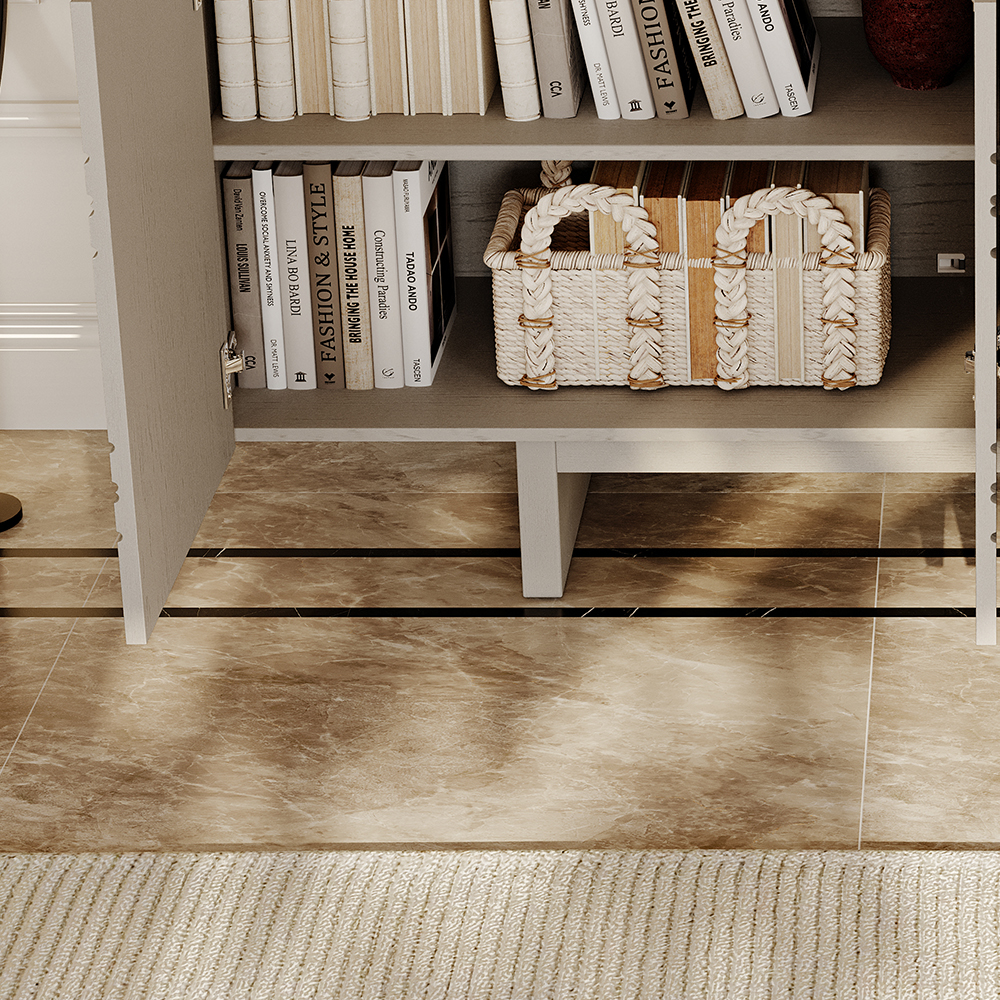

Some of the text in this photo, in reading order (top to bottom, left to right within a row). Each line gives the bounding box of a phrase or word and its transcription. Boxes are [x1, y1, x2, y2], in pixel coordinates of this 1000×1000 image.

[579, 0, 591, 26] SHYNESS
[606, 0, 625, 37] BARDI
[684, 0, 702, 19] THE
[722, 1, 742, 41] Paradies
[758, 3, 775, 32] ANDO
[691, 20, 717, 67] BRINGING
[550, 80, 563, 98] CCA
[785, 83, 799, 111] TASCEN
[259, 191, 268, 222] OVERCOME
[262, 223, 270, 243] SOCIAL
[236, 243, 251, 292] LOUIS SULLIVAN
[263, 244, 271, 268] ANXIETY
[285, 239, 302, 316] LINA BO BARDI
[310, 183, 337, 362] FASHION & STYLE
[342, 225, 362, 343] BRINGING THE HOUSE HOME
[373, 230, 390, 320] Constructing Paradies
[405, 252, 418, 311] TADAO ANDO
[265, 282, 274, 306] SHYNESS
[413, 359, 421, 382] TASCEN
